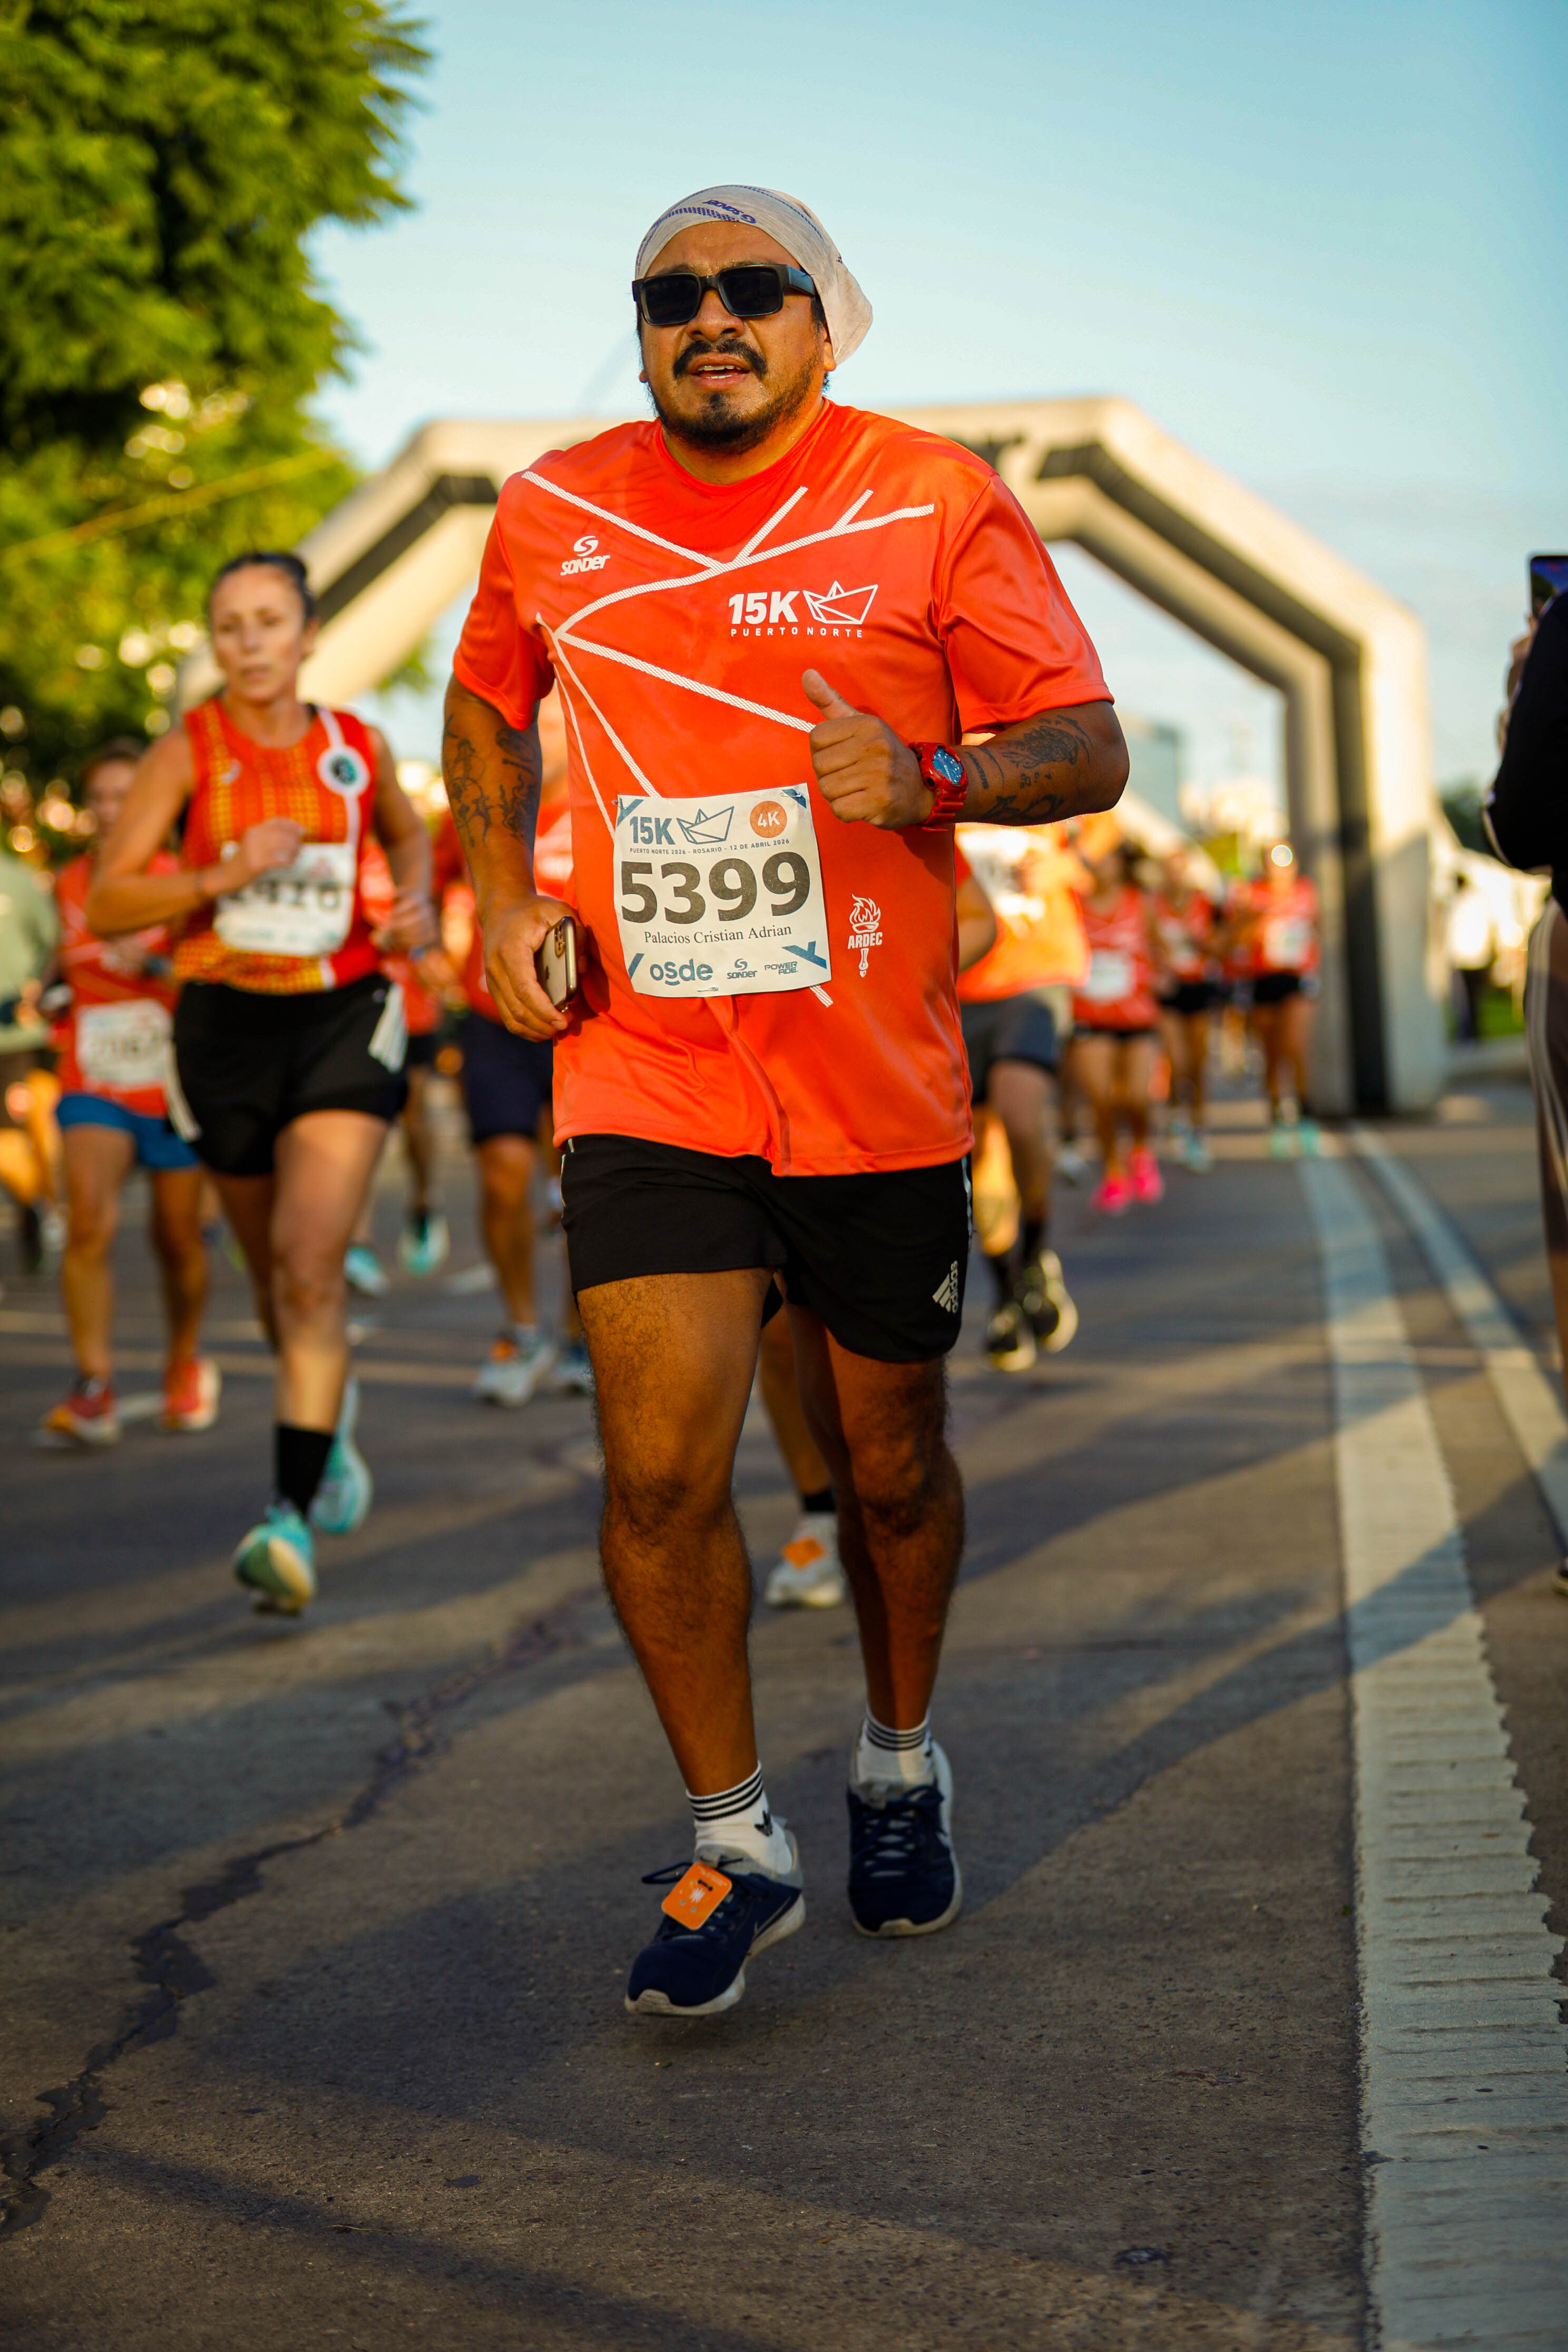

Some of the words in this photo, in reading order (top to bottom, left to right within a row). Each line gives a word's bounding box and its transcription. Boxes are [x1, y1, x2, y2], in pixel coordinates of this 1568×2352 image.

[728, 591, 800, 625] 15K
[730, 627, 798, 637] PUERTO
[807, 627, 863, 638] NORTE
[757, 810, 780, 827] 4K
[629, 816, 675, 845] 15K
[621, 852, 810, 925] 5399
[644, 931, 690, 944] Palacios
[694, 929, 743, 944] Cristian
[748, 925, 792, 939] Adrian
[847, 932, 883, 949] ARDEC
[650, 958, 713, 982] osde
[765, 961, 798, 971] POWER
[949, 1260, 958, 1314] adidas
